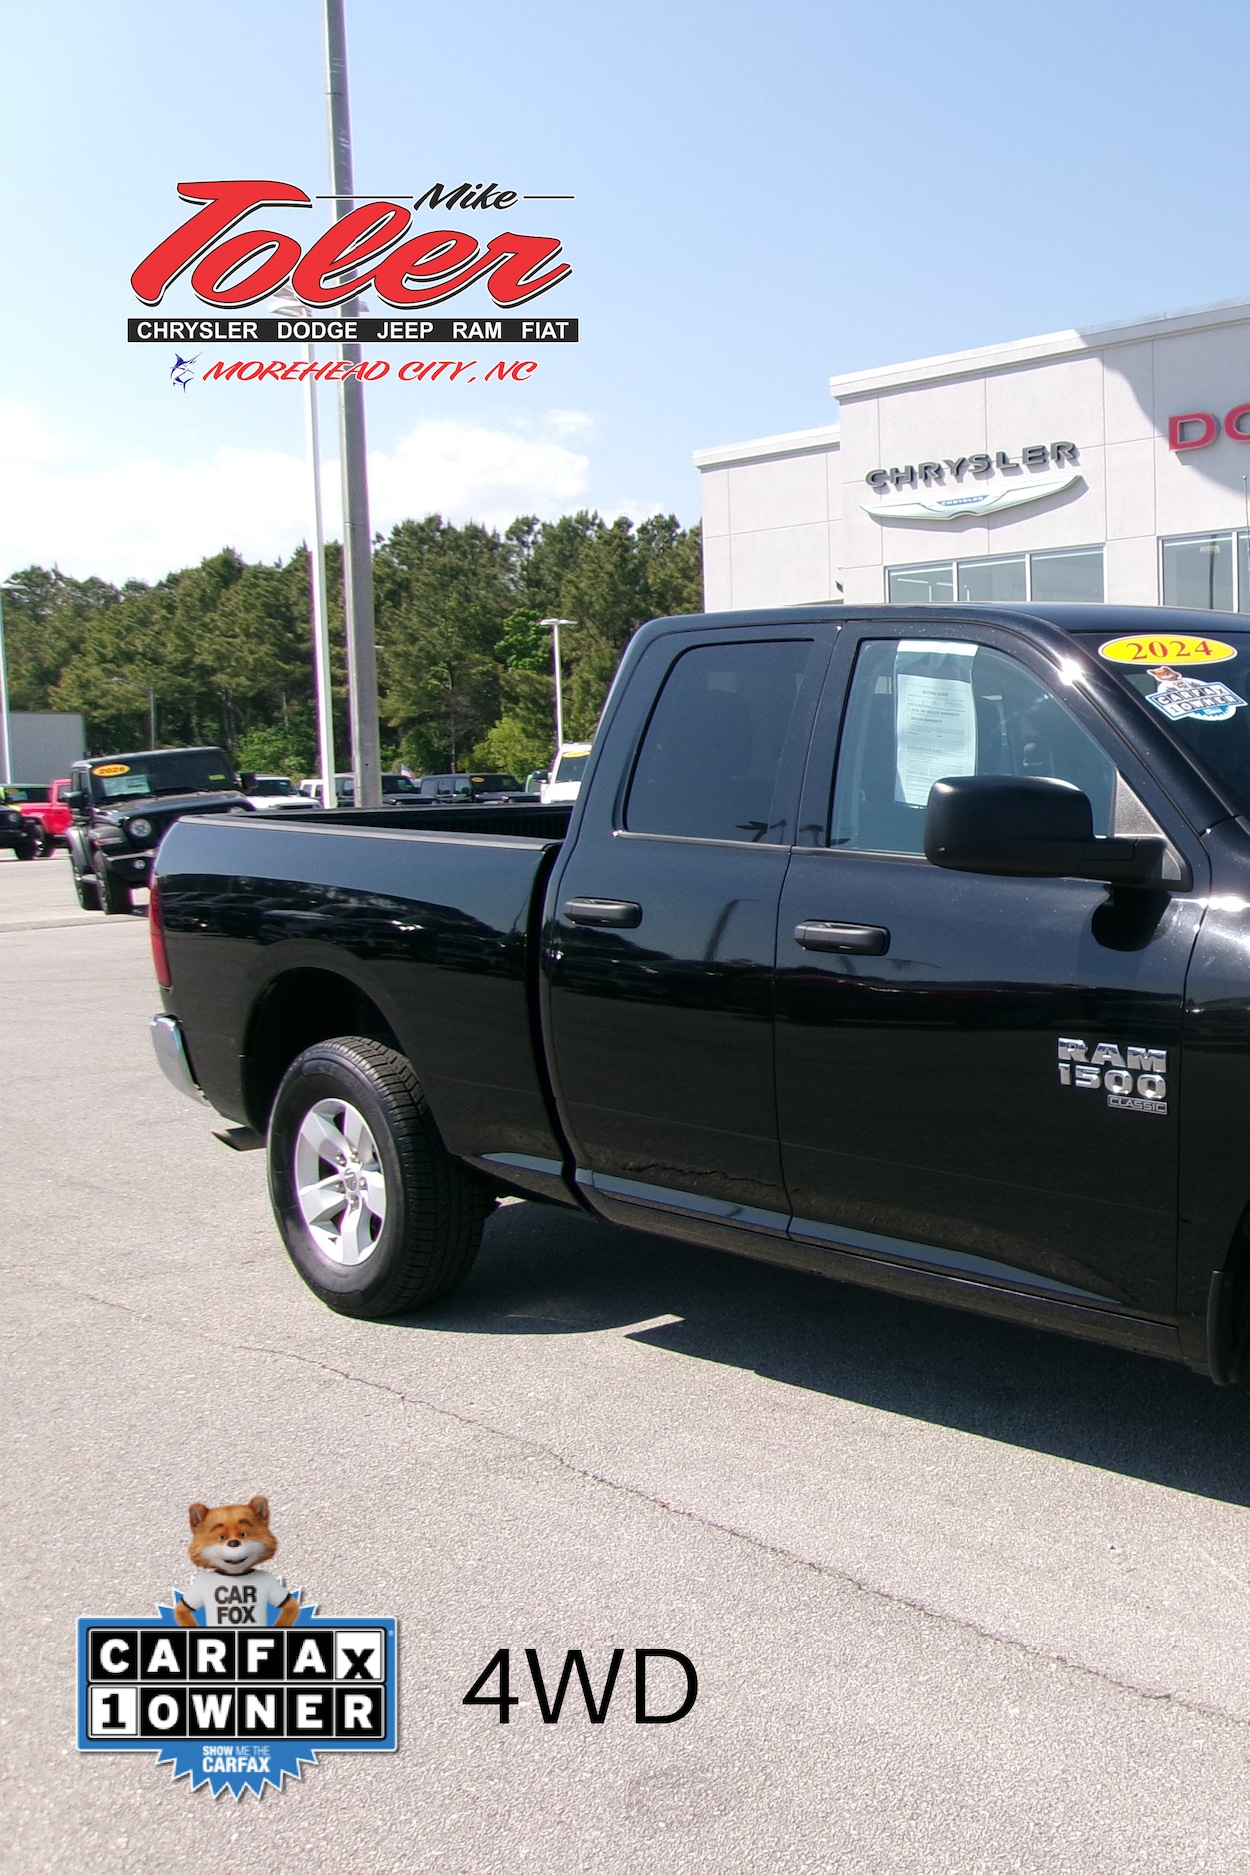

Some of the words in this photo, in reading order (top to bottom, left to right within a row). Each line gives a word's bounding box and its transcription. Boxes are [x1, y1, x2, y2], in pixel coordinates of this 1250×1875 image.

[865, 441, 1080, 488] CHRYSLER
[1126, 640, 1213, 660] 2024
[1157, 687, 1226, 704] CARFAX
[1058, 1037, 1167, 1073] RAM
[1058, 1063, 1167, 1099] 1500
[1109, 1097, 1167, 1113] CLASSIC
